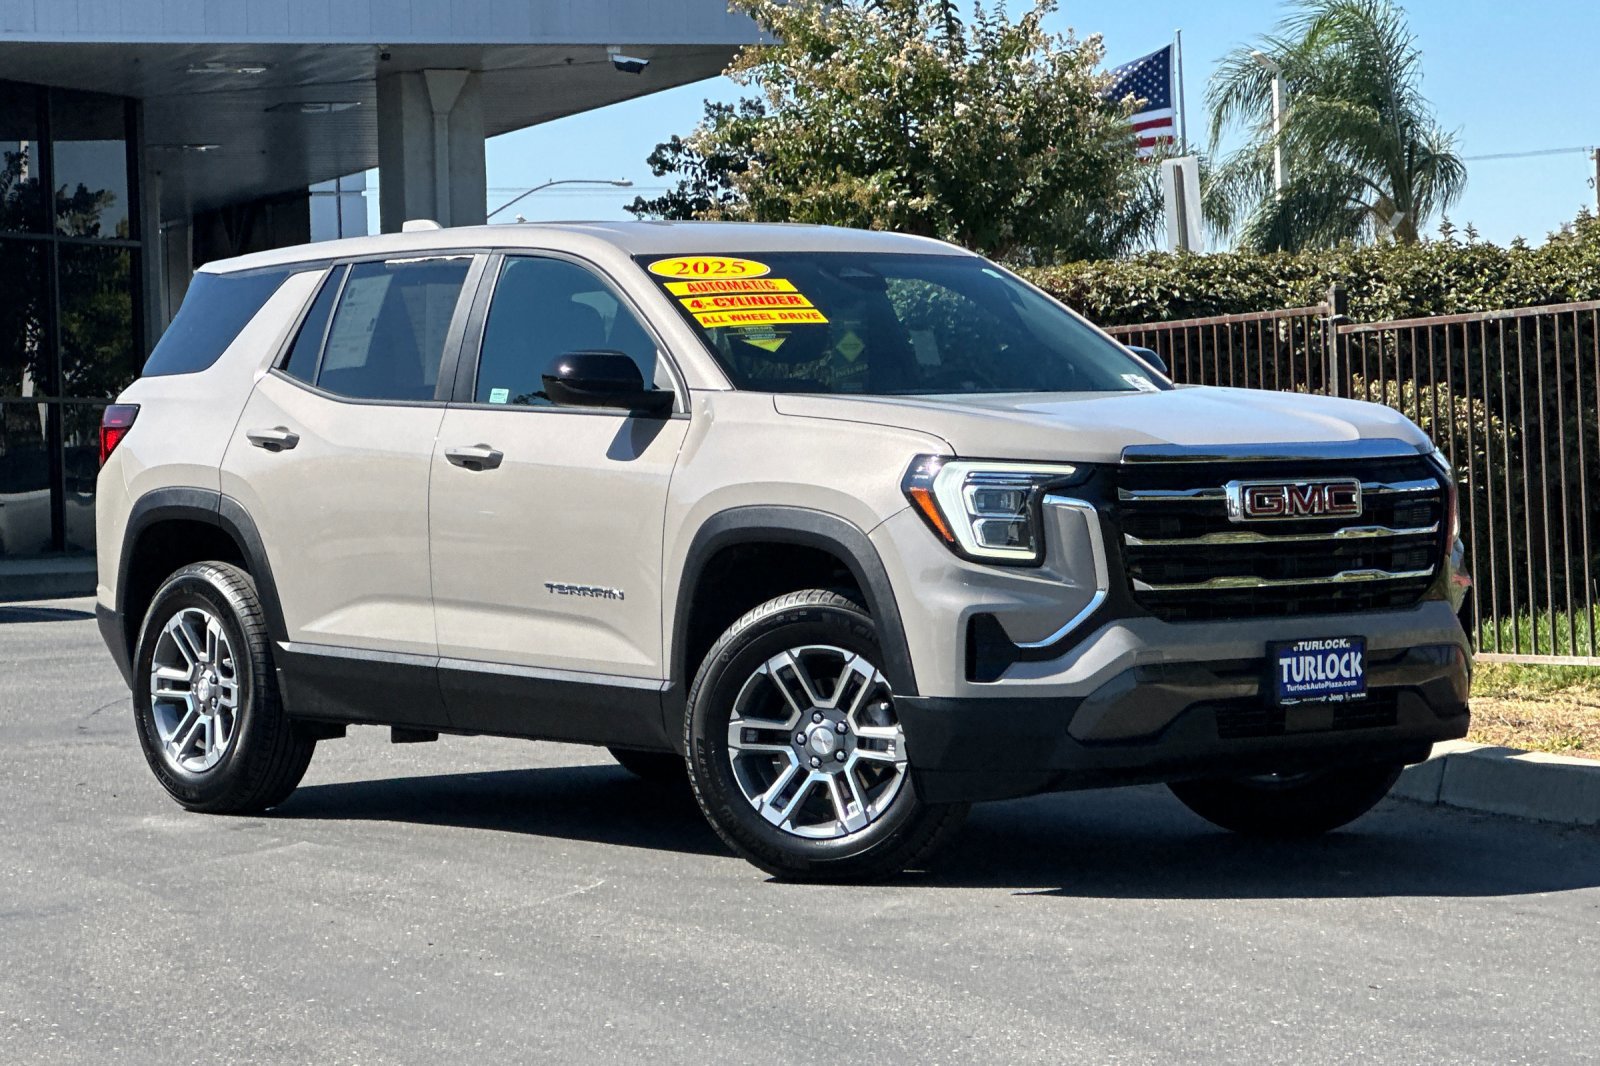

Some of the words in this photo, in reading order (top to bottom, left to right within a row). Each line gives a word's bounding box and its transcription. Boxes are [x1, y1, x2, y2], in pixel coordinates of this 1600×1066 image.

[674, 262, 746, 275] 2025
[687, 280, 778, 293] AUTOMATIC
[690, 296, 801, 309] 4-CYLINDER
[702, 315, 725, 324] ALL
[729, 312, 776, 322] WHEEL
[778, 312, 820, 321] DRIVE
[1246, 484, 1358, 515] GMC
[1298, 639, 1346, 651] TURLOCK
[1279, 651, 1363, 683] TURLOCK
[1286, 680, 1357, 691] TurlockAutoPlaza.com
[1328, 693, 1344, 702] Jeep
